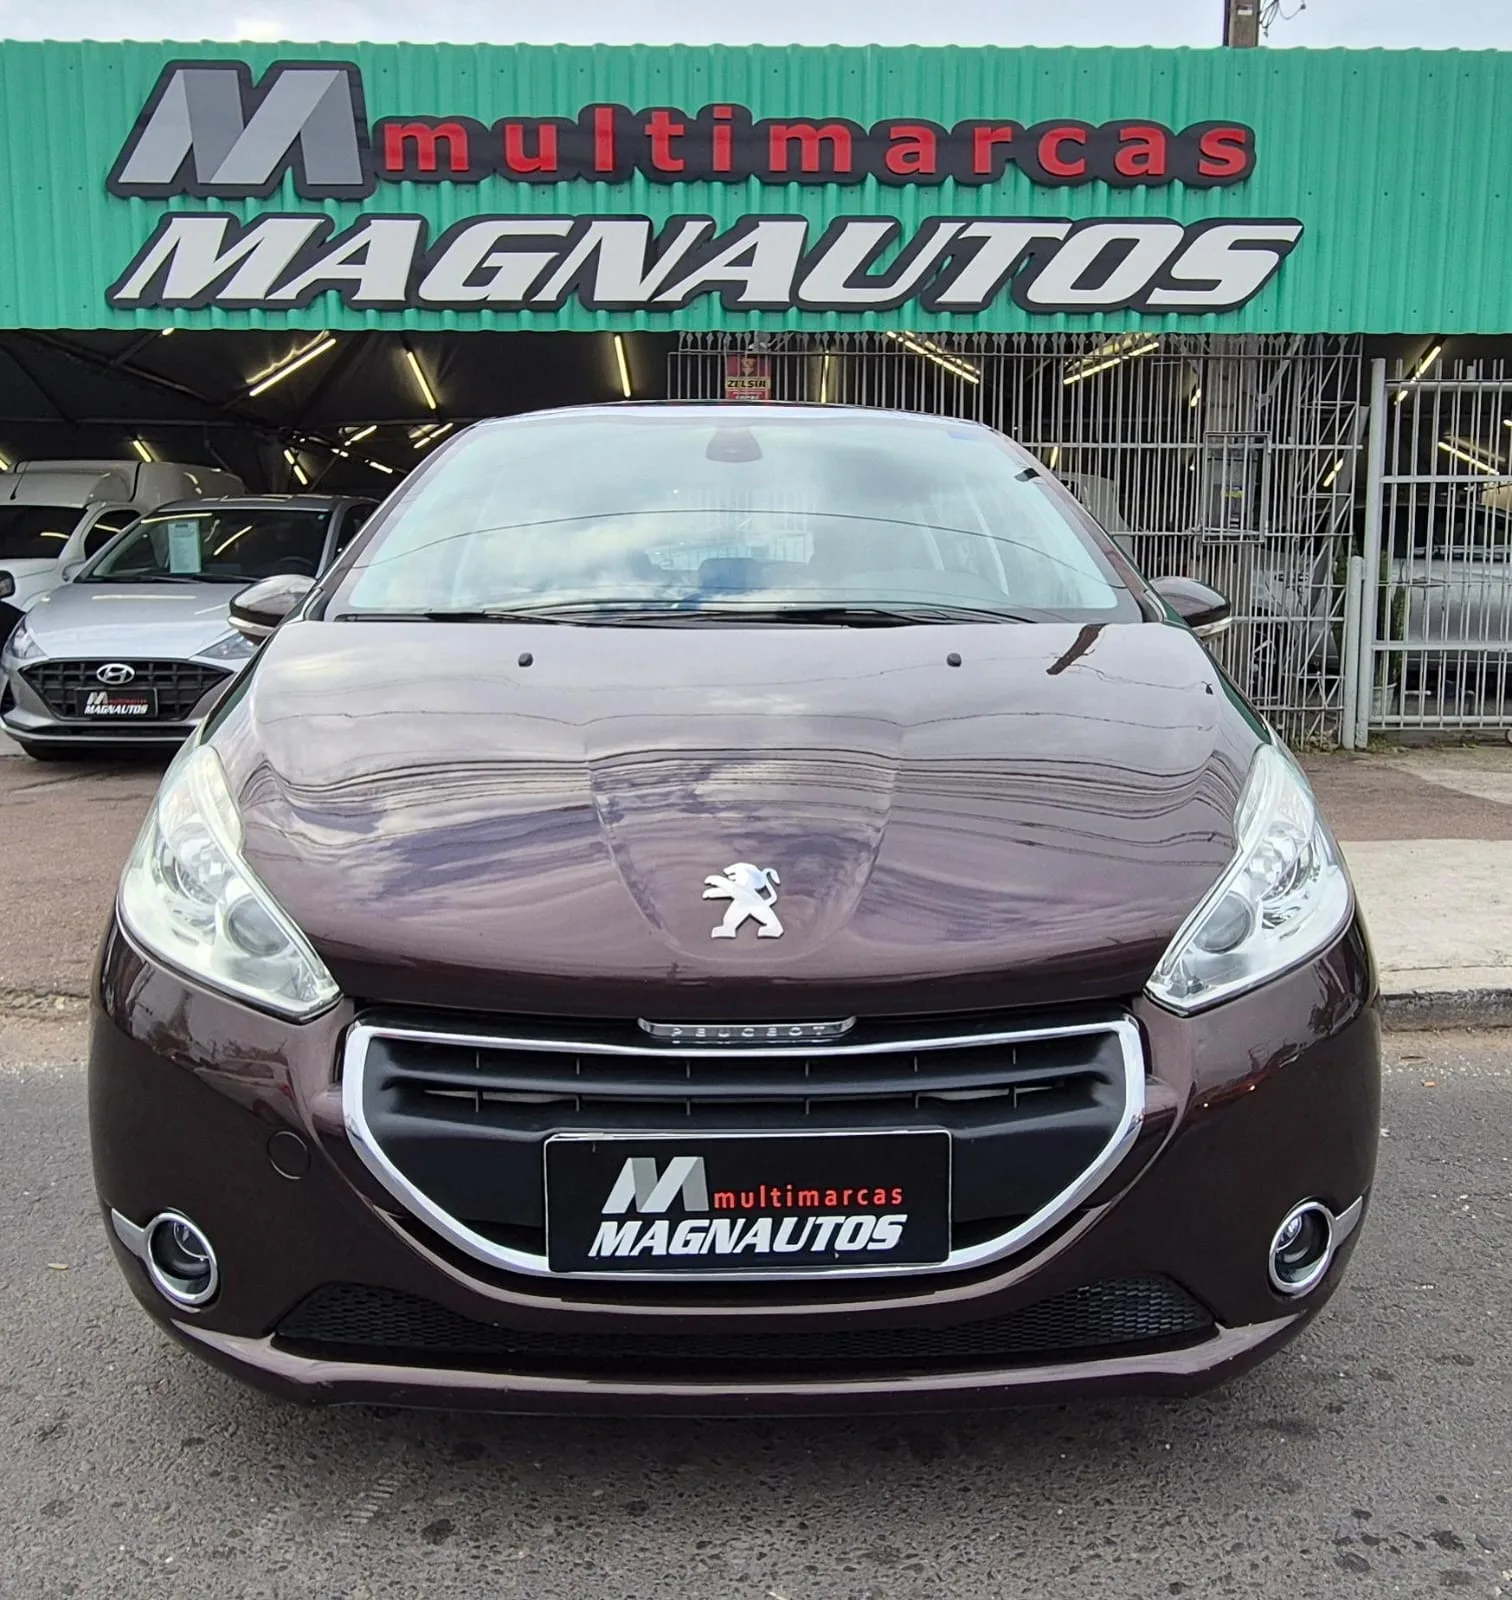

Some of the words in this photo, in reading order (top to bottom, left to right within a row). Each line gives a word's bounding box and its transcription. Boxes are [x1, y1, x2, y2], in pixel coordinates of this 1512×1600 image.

[384, 106, 1248, 177] multimarcas
[113, 217, 1303, 305] MAGNAUTOS
[84, 704, 149, 715] MAGNAUTOS
[714, 1184, 903, 1209] multimarcas
[588, 1214, 908, 1257] MAGNAUTOS
